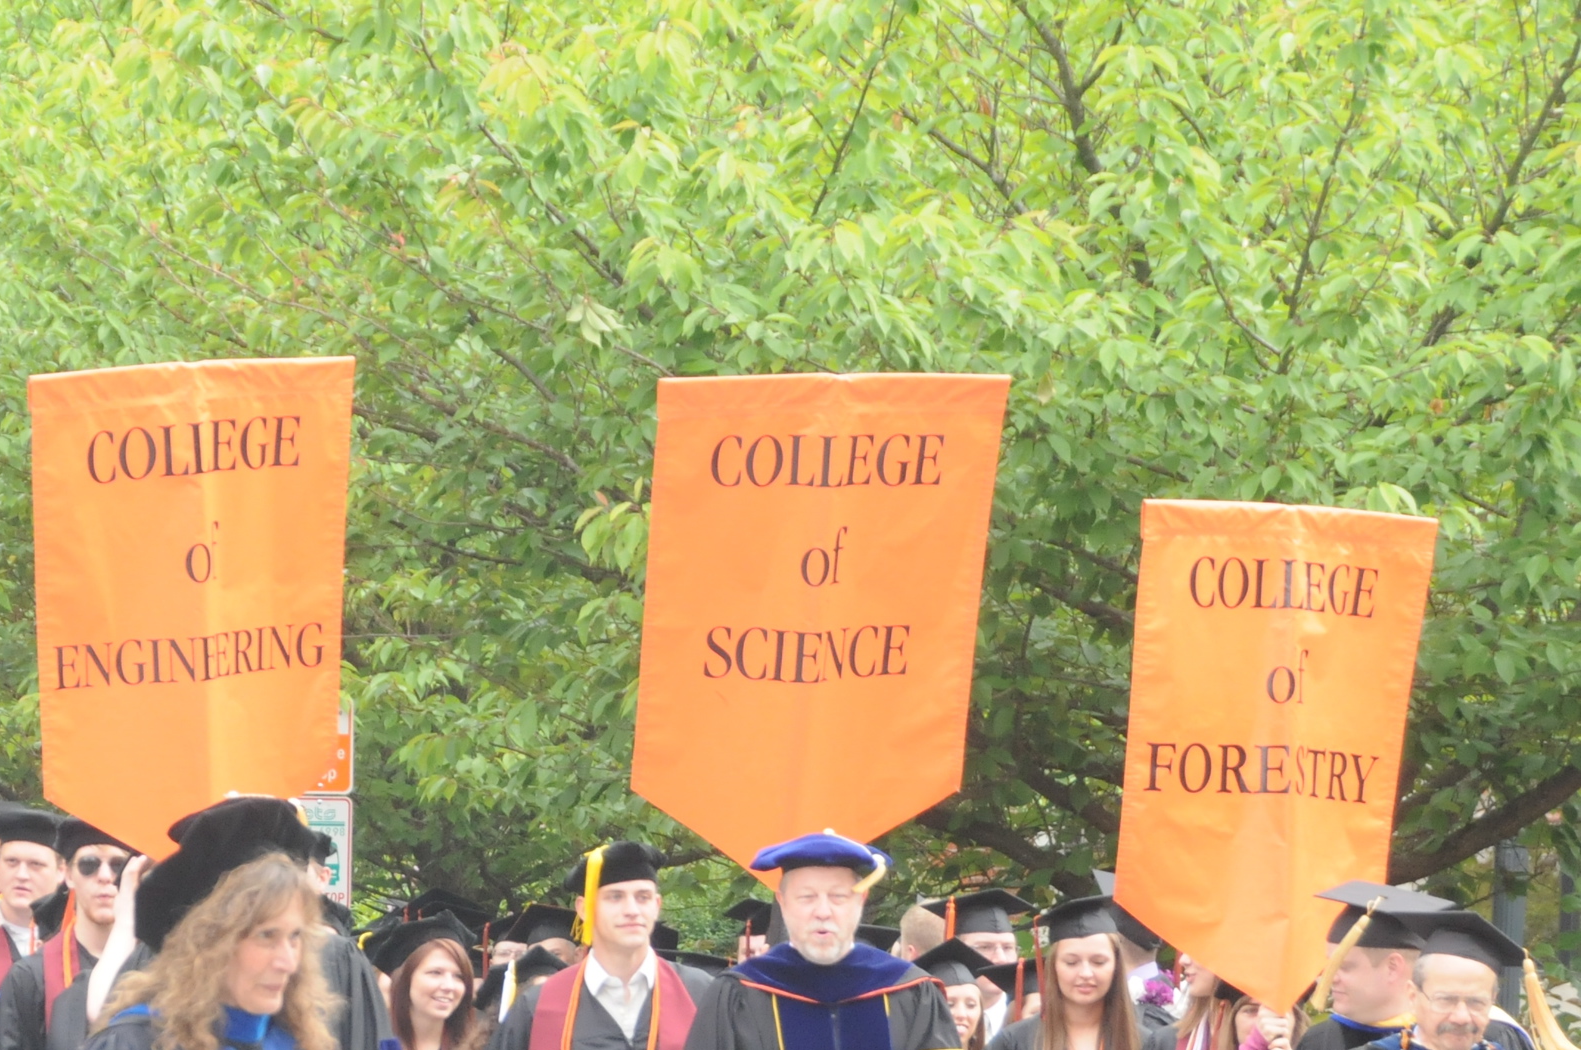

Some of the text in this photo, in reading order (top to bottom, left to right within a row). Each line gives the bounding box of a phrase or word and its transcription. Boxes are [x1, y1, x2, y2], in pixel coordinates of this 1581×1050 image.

[710, 433, 945, 488] COLLEGE
[800, 526, 848, 588] of
[1189, 555, 1380, 619] COLLEGE
[53, 622, 326, 691] ENGINEERING
[703, 624, 911, 685] SCIENCE
[1266, 648, 1310, 704] of
[1142, 741, 1380, 804] FORESTRY
